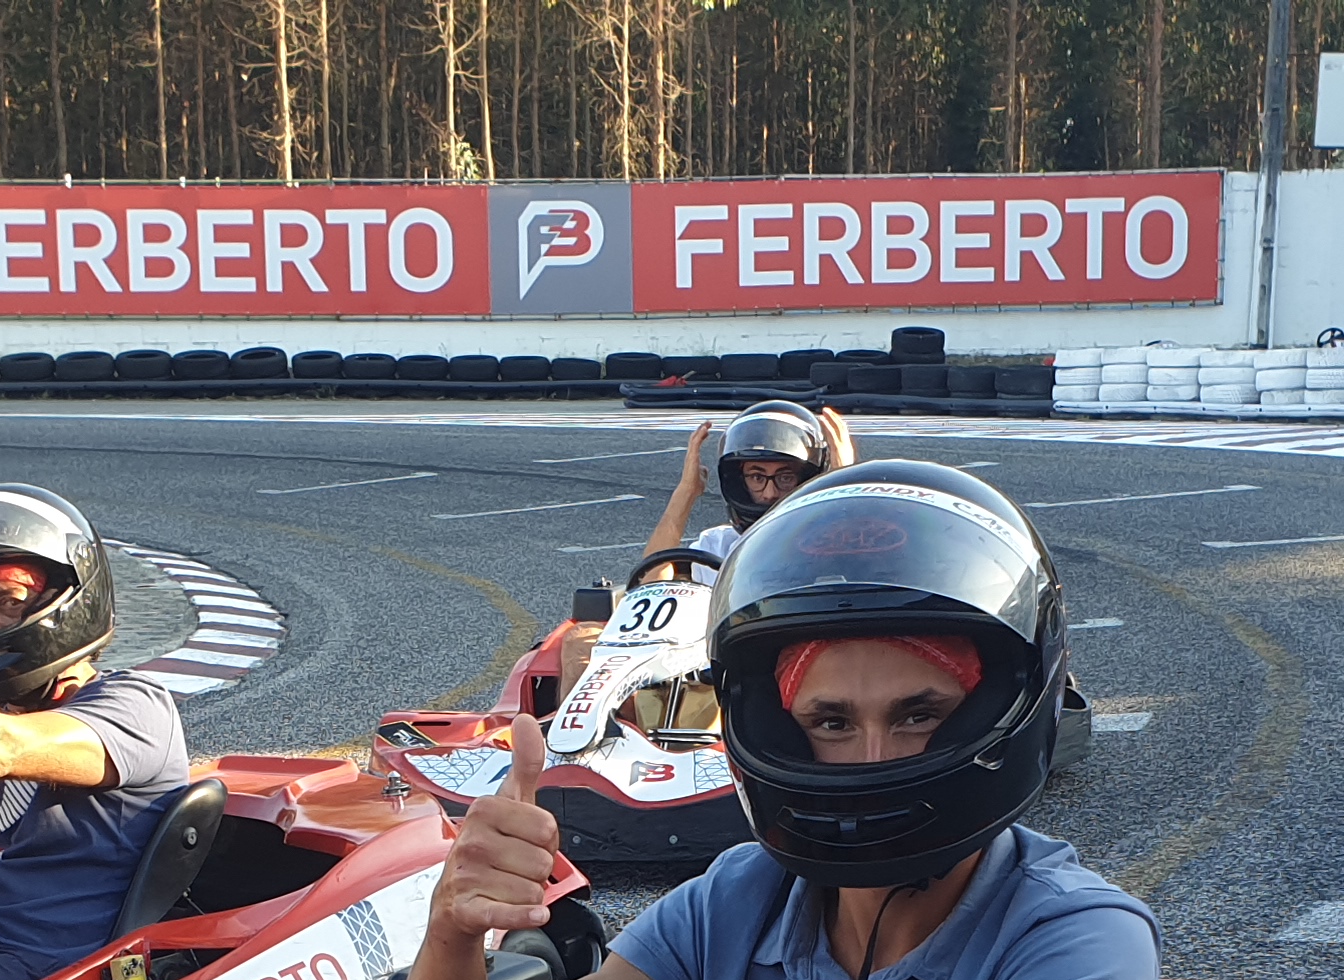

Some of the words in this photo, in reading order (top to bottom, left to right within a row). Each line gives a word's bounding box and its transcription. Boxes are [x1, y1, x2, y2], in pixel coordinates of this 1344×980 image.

[674, 196, 1189, 288] FERBERTO
[625, 588, 697, 602] EUROINDY
[619, 597, 678, 633] 30
